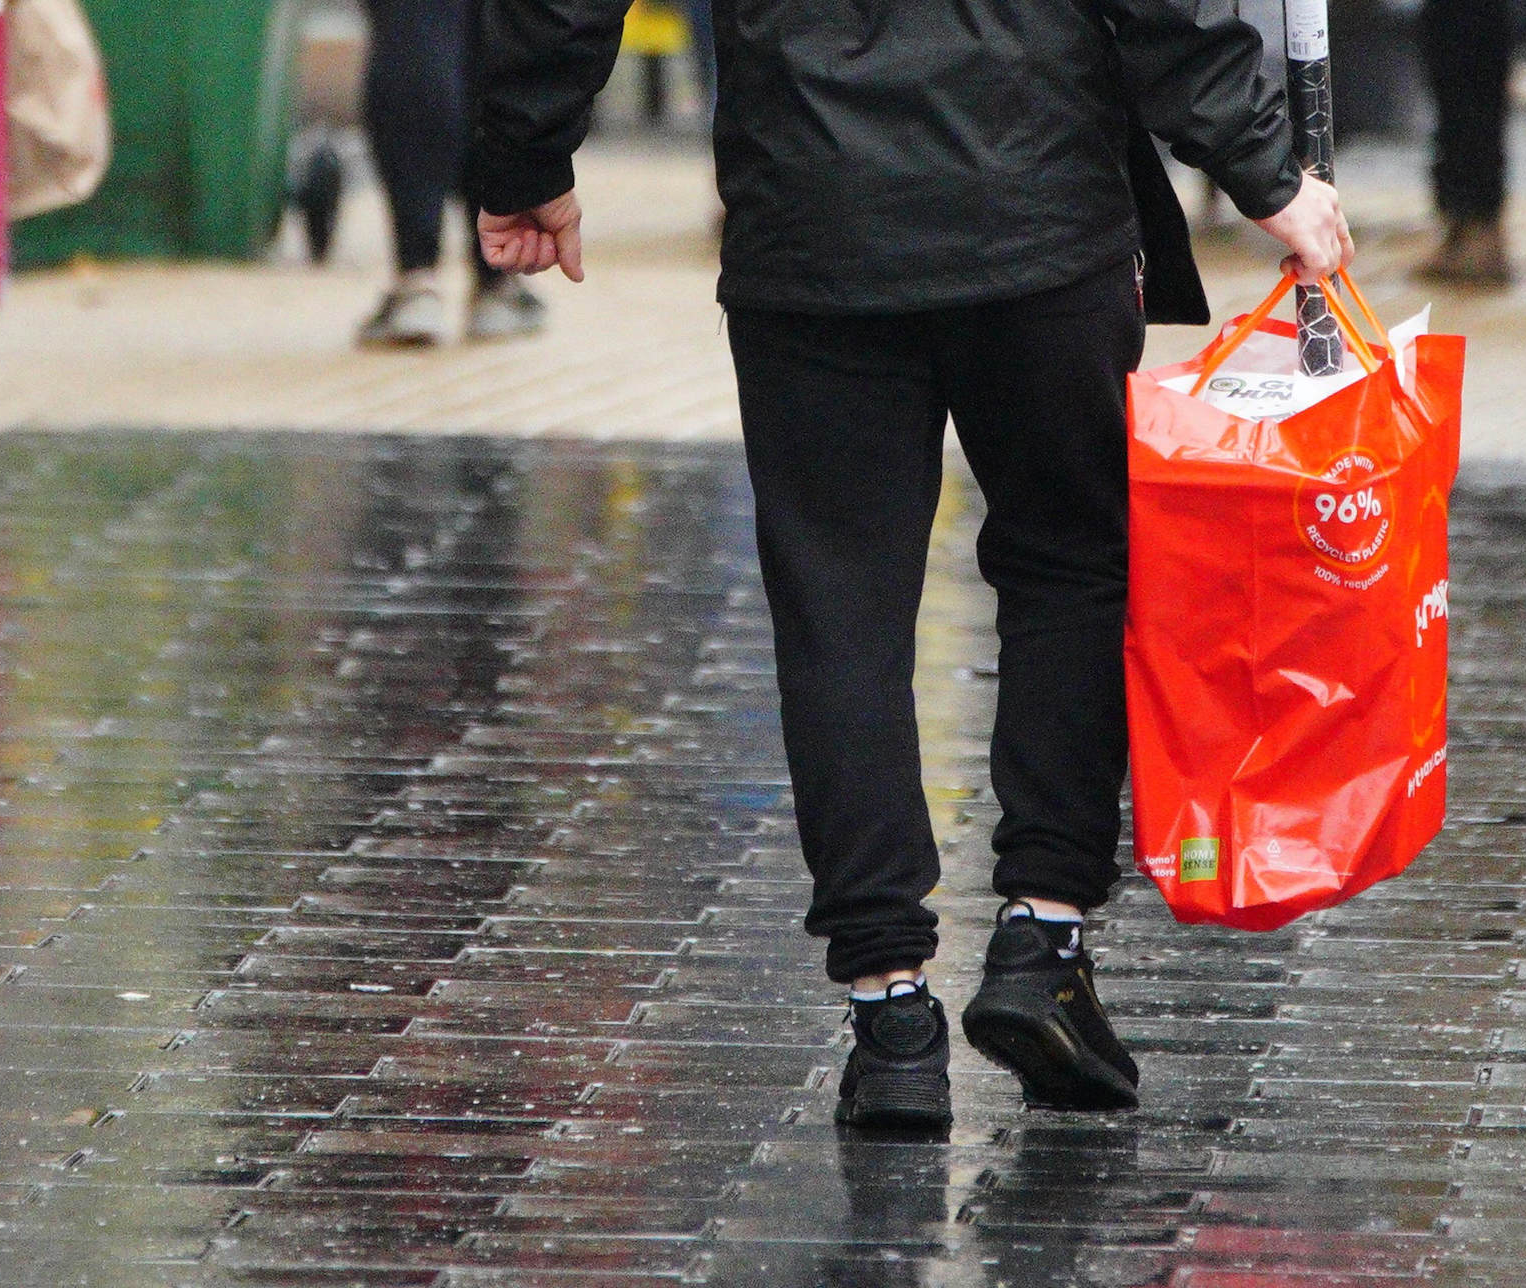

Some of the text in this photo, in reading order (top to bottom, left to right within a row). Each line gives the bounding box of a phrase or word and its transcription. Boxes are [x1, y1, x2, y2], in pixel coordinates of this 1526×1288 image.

[1320, 455, 1375, 482] MADE WITH
[1314, 486, 1383, 524] 96%
[1306, 518, 1390, 563] RECYCLED PLASTIC
[1313, 563, 1390, 591] 100% recyclable
